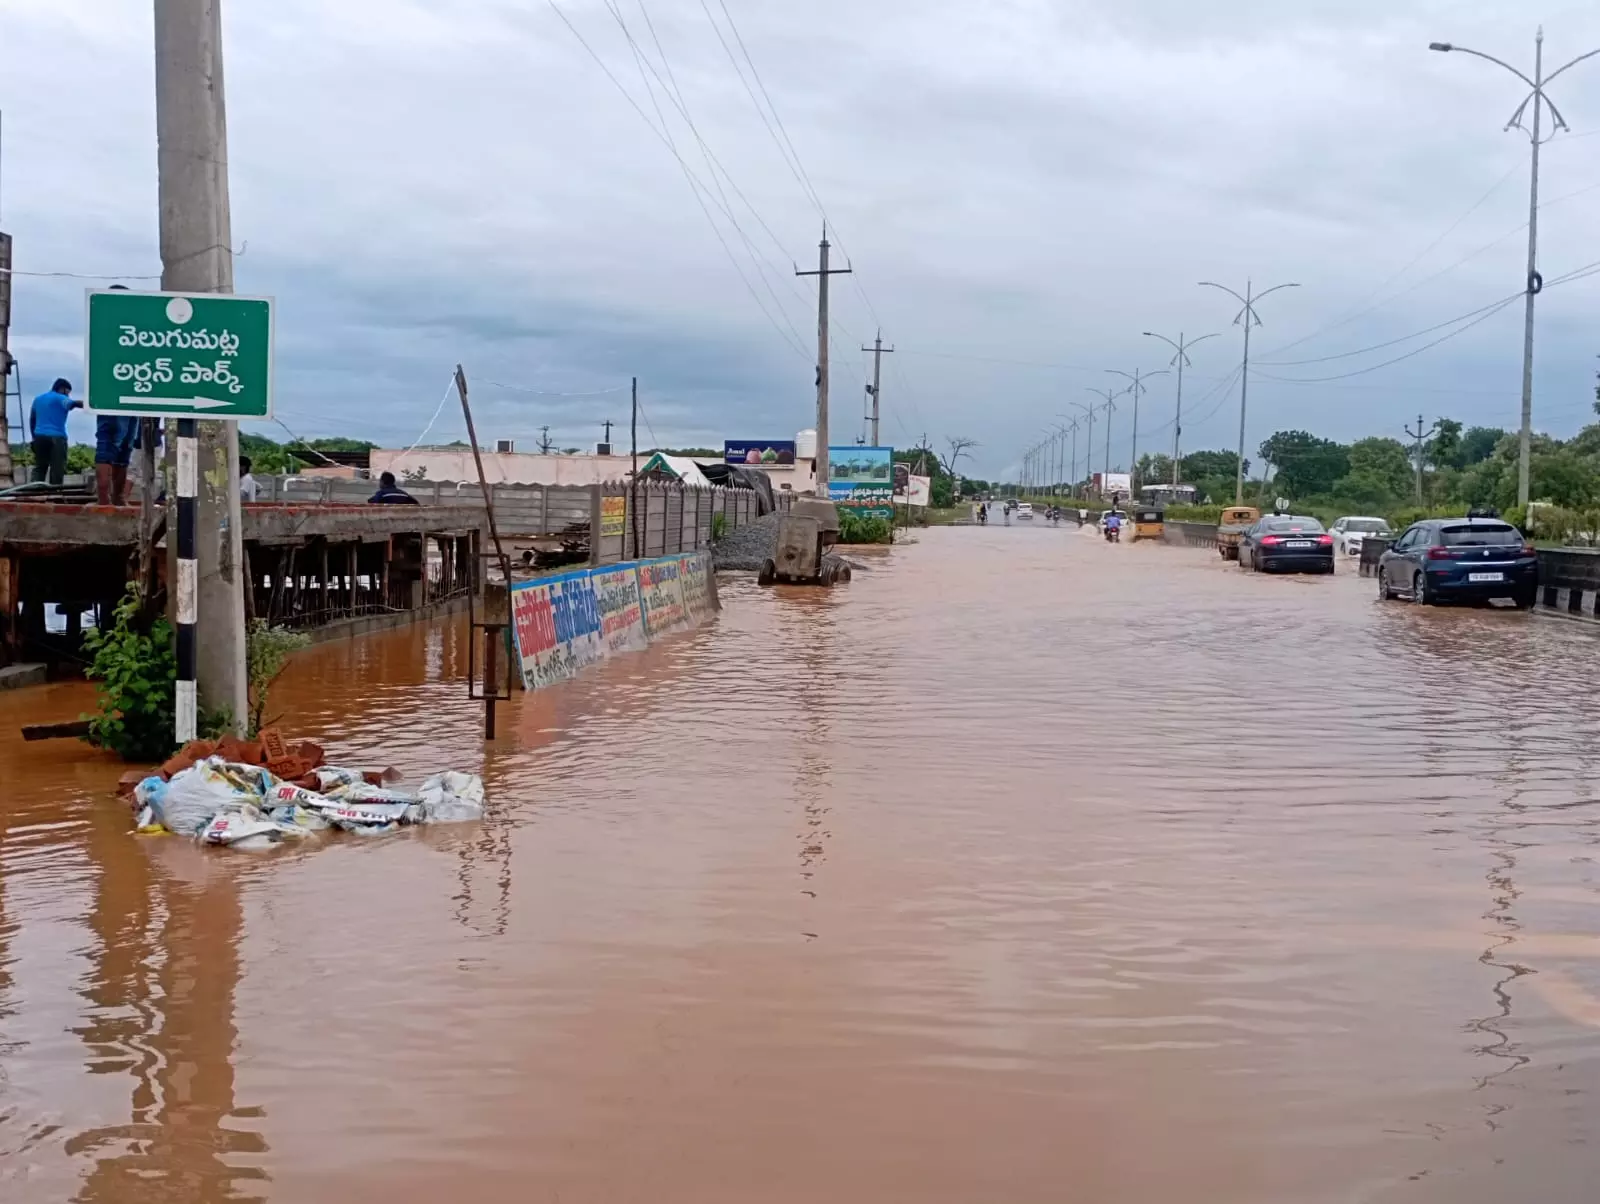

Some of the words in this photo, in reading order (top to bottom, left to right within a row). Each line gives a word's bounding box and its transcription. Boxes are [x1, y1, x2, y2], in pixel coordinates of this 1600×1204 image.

[118, 325, 240, 357] వెలుగుమట్ల
[113, 358, 174, 393] అర్బన్
[180, 360, 244, 394] పార్క్
